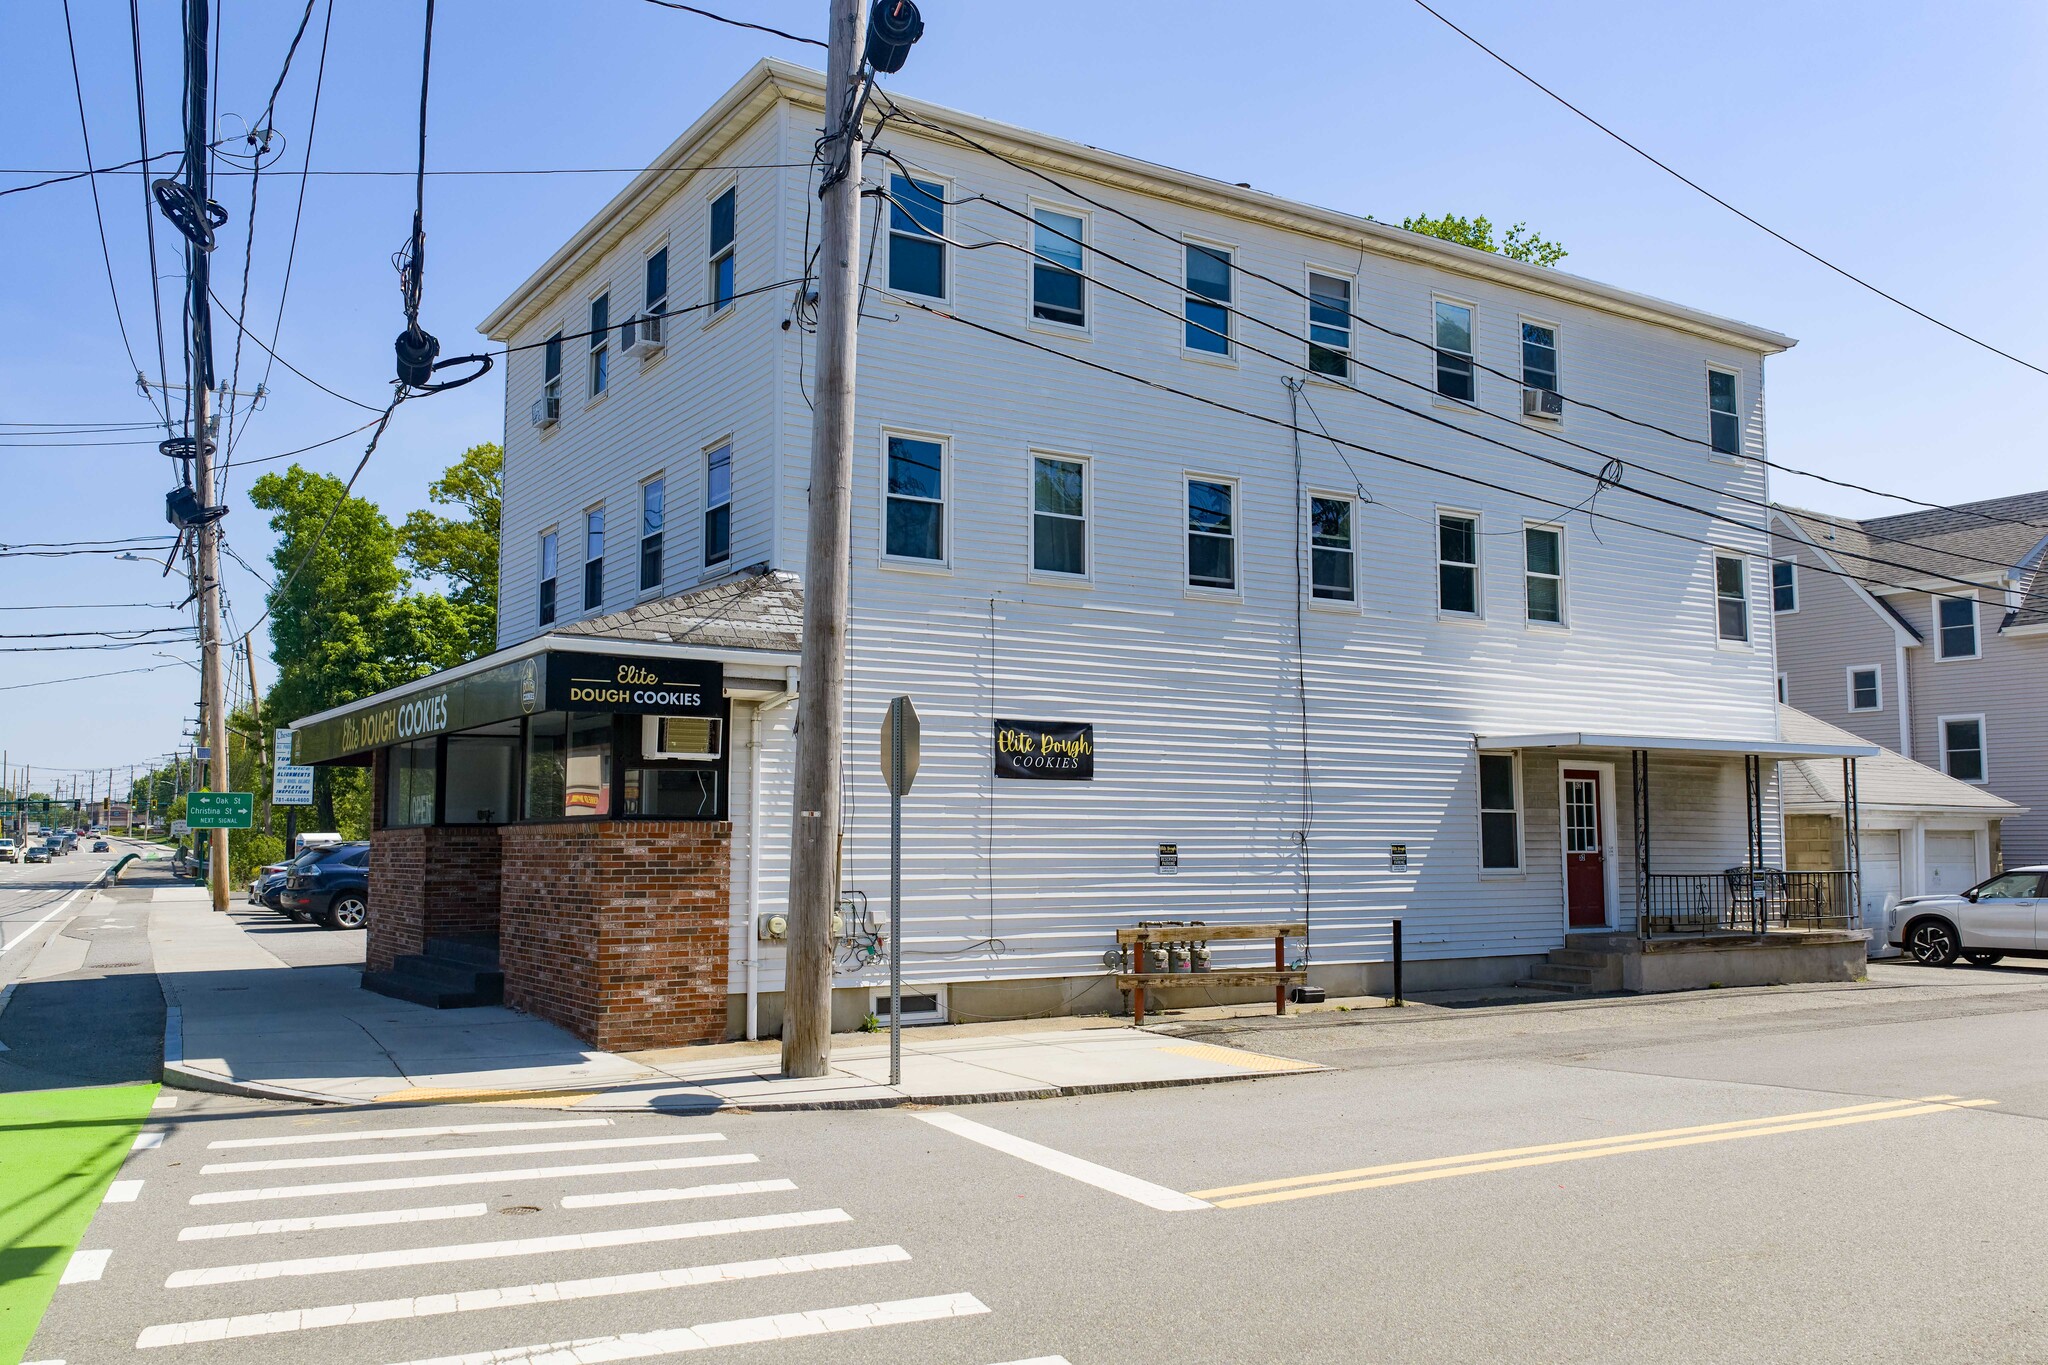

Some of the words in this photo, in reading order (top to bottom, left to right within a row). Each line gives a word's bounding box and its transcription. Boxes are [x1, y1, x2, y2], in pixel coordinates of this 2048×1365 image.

[617, 664, 659, 685] Elite
[570, 688, 630, 703] DOUGH
[633, 690, 701, 706] COOKIES
[341, 718, 360, 752] Elite
[360, 708, 396, 747] DOUGH
[397, 693, 448, 738] COOKIES
[997, 729, 1036, 754] Elite
[1040, 733, 1092, 758] Dough
[1013, 755, 1079, 769] COOKIES
[215, 796, 229, 805] Oak
[233, 796, 241, 805] St
[190, 807, 221, 815] Christina
[225, 807, 232, 815] St
